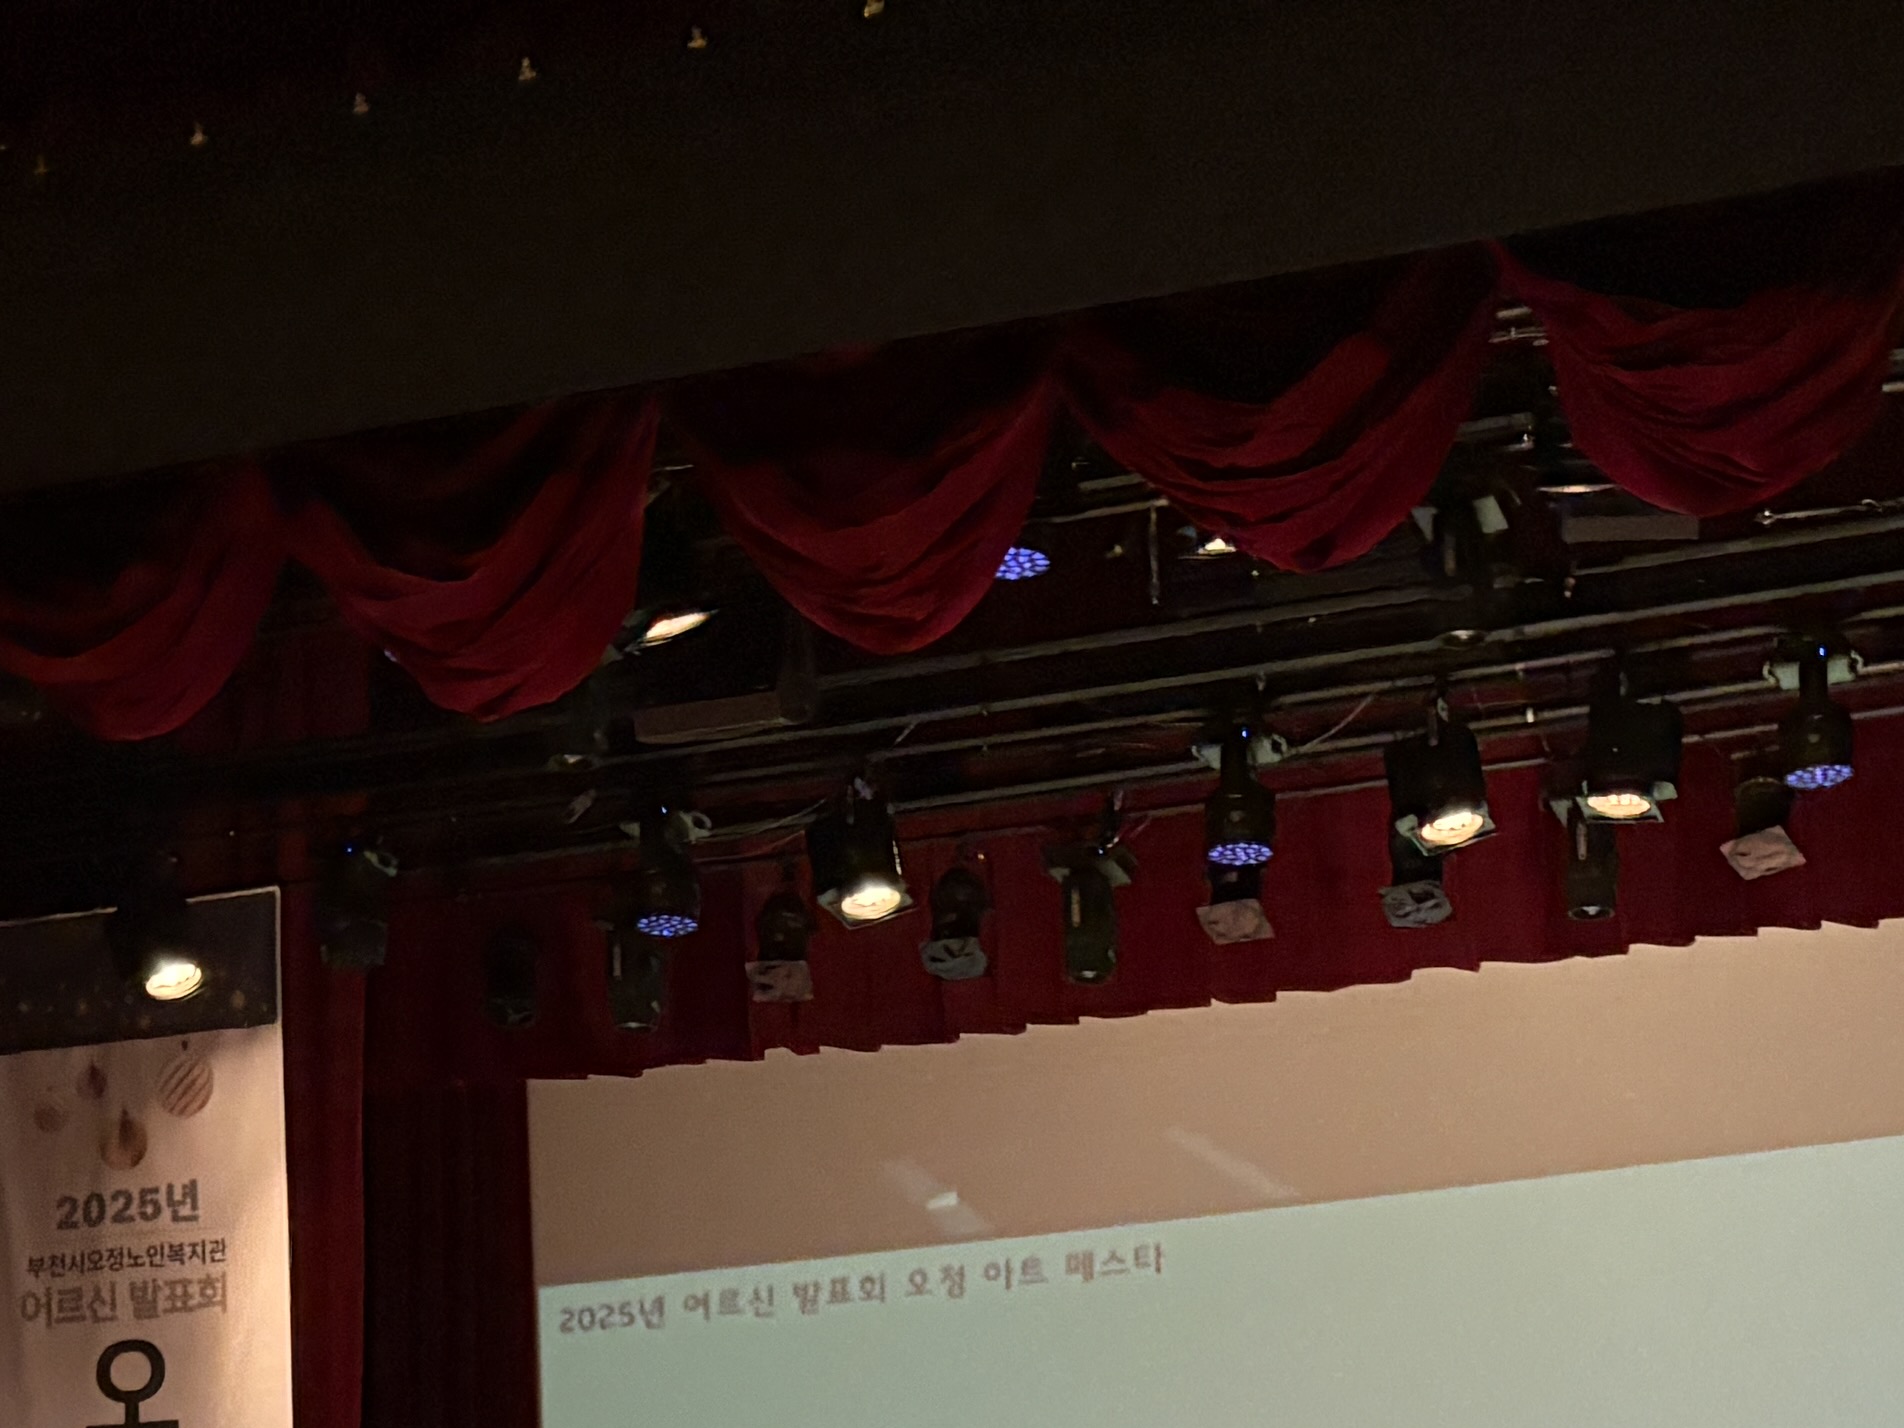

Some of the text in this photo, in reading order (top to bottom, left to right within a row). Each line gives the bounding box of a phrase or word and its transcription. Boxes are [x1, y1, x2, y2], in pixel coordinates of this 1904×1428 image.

[57, 1178, 200, 1231] 2025년
[26, 1237, 228, 1280] 부천시오정노인복지관
[20, 1270, 228, 1330] 어르신 발표회
[559, 1242, 1163, 1334] 2025년 어르신 발표회 오정 아트 페스타
